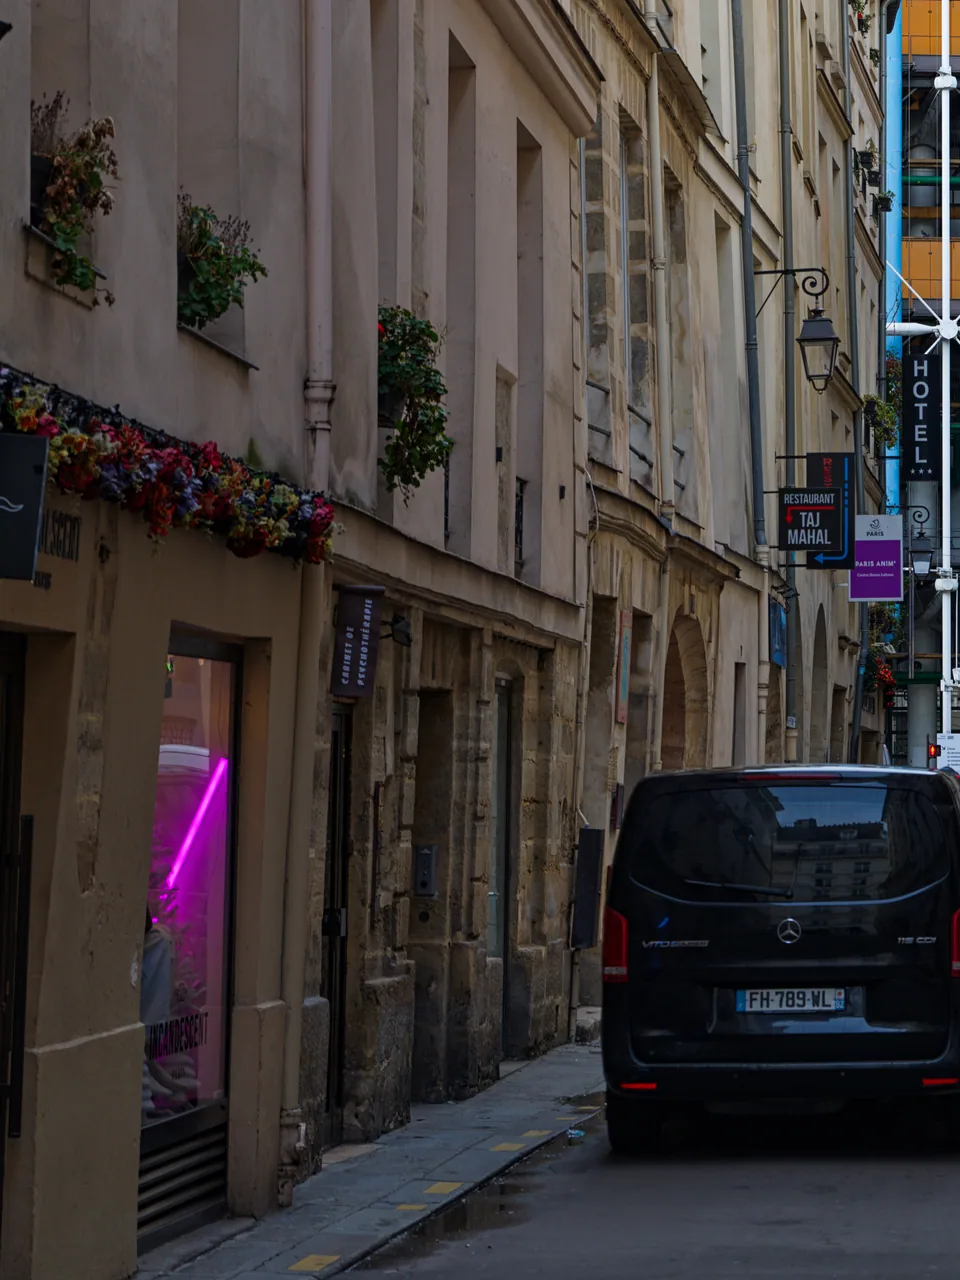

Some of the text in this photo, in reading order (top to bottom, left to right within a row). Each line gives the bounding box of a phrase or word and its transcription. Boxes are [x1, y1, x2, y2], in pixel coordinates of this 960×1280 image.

[912, 360, 930, 464] HOTEL
[784, 493, 835, 504] RESTAURANT
[799, 512, 820, 527] TAJ
[787, 528, 832, 545] MAHAL
[357, 598, 373, 686] PSYCHOTHÉRAPIE
[341, 626, 354, 685] CABINET DE
[641, 940, 670, 948] VITO
[749, 990, 831, 1008] FH-789-WL
[835, 1000, 844, 1009] 92
[149, 1012, 209, 1060] INCANDESCENT
